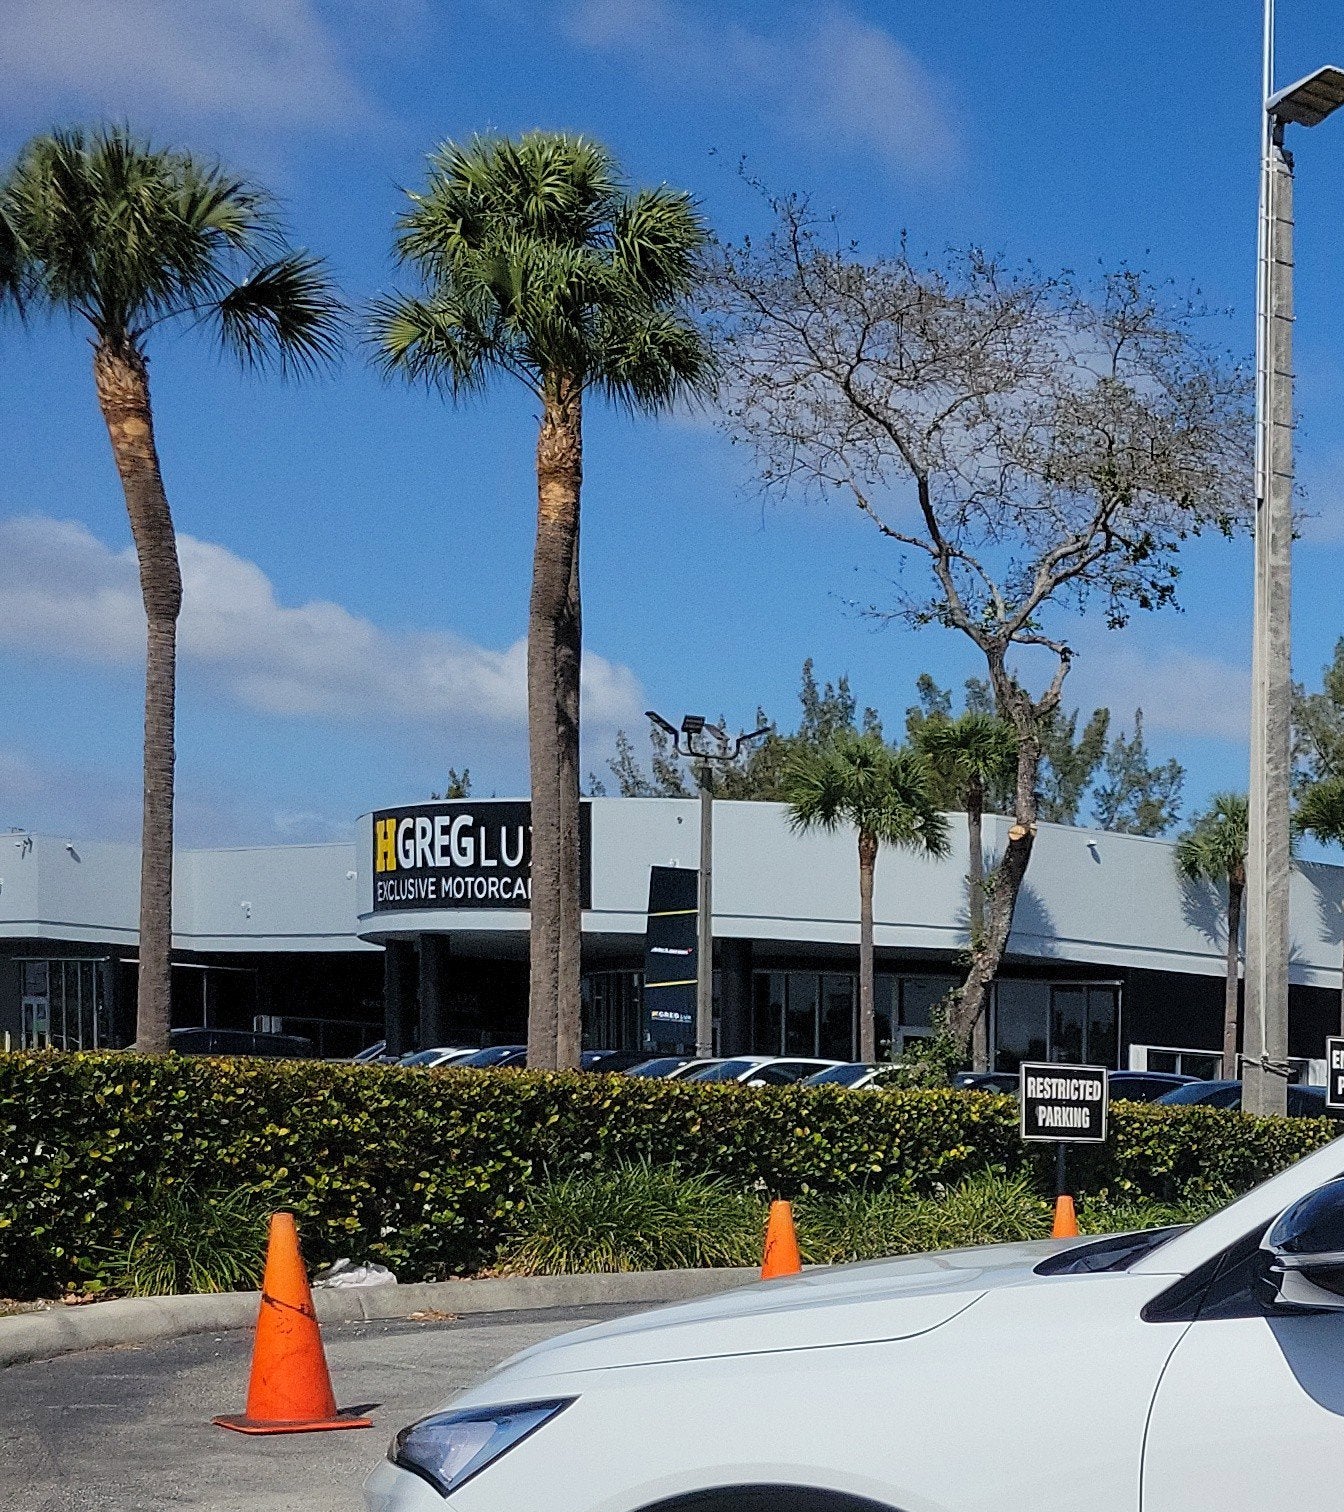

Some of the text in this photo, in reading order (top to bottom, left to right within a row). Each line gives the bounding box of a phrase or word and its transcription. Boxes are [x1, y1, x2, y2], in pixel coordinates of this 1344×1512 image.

[480, 825, 533, 868] LU
[377, 876, 532, 901] EXCLUSIVE MOTORCA
[1027, 1076, 1102, 1101] RESTRICTED
[1037, 1104, 1090, 1129] PARKING
